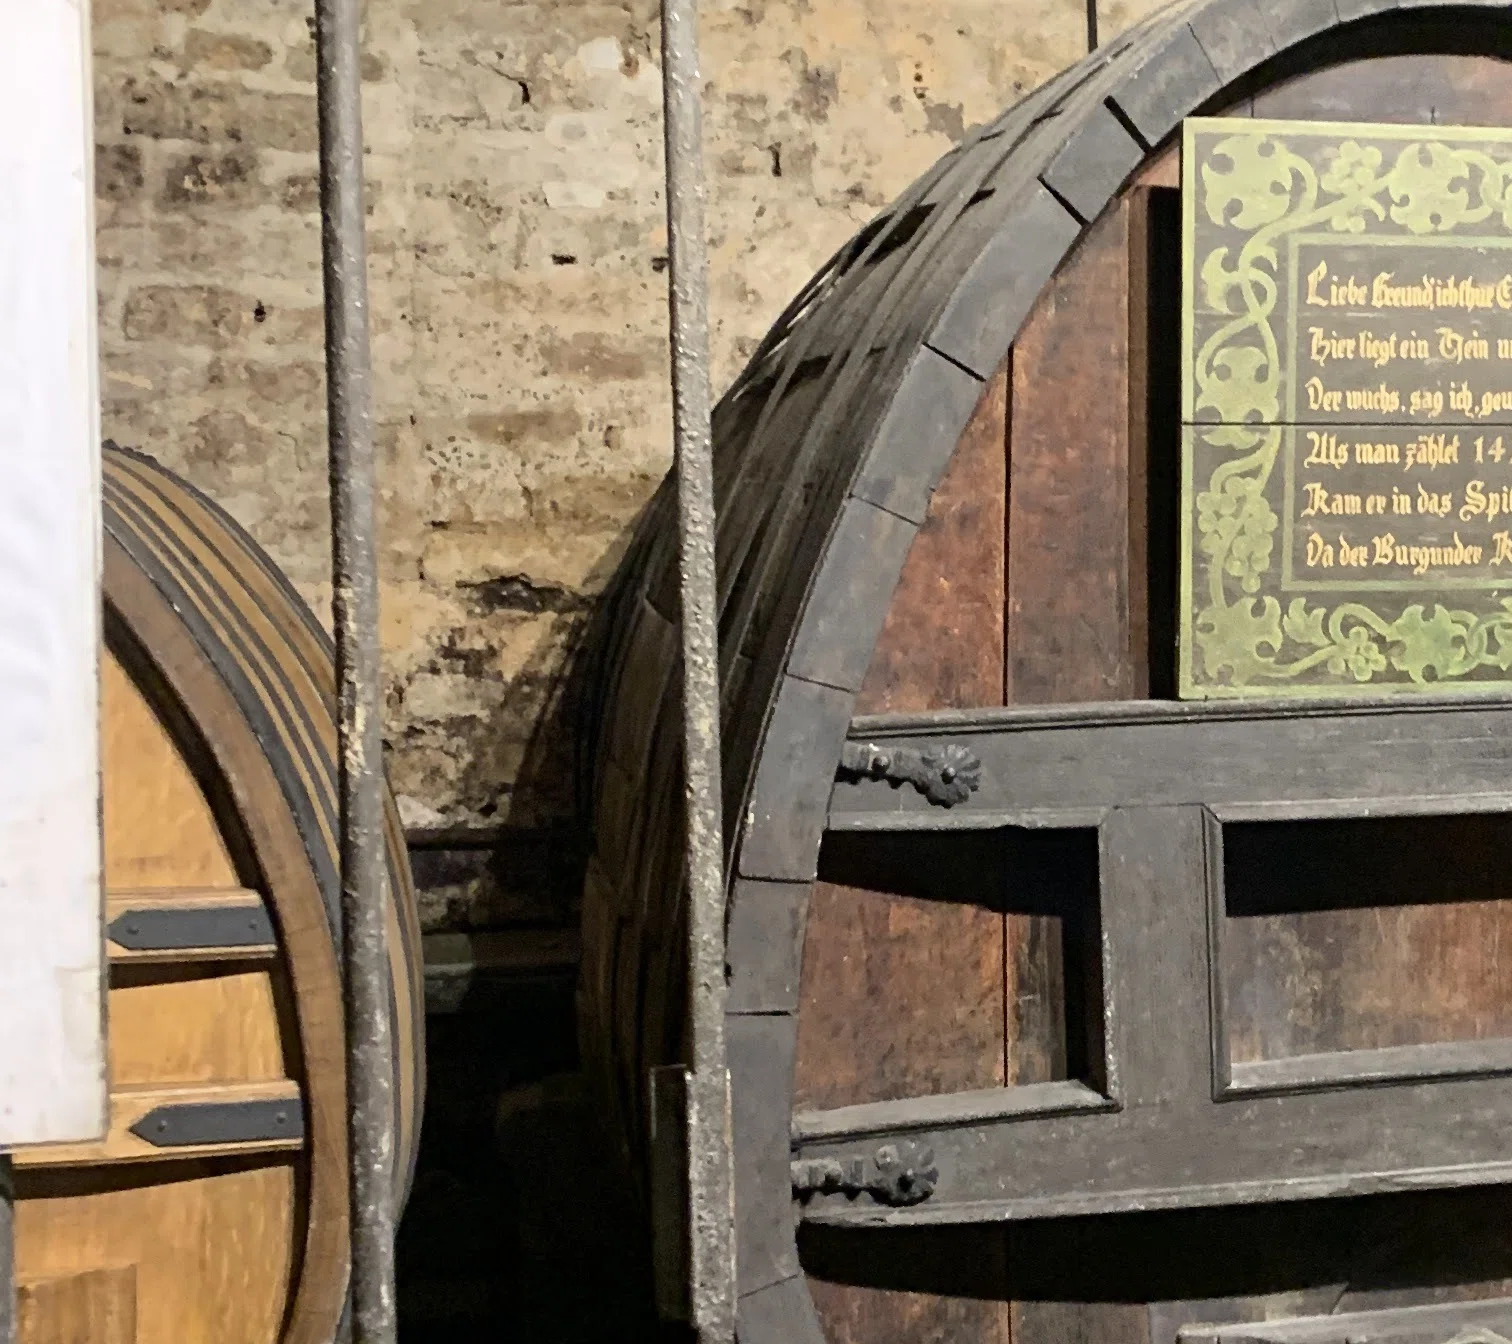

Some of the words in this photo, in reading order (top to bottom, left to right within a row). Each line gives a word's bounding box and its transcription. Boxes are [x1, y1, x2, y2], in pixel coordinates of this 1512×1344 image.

[1306, 260, 1368, 307] Liebe
[1308, 326, 1356, 367] Hier
[1359, 330, 1397, 368] liegt
[1400, 330, 1430, 360] ein
[1304, 376, 1343, 412] Der
[1303, 431, 1349, 469] Als
[1355, 442, 1400, 464] man
[1300, 482, 1362, 517] Kam
[1366, 494, 1387, 515] er
[1392, 486, 1412, 515] in
[1417, 483, 1452, 518] das
[1306, 532, 1334, 568] Da
[1339, 532, 1368, 567] der
[1372, 531, 1483, 575] Burgunder
